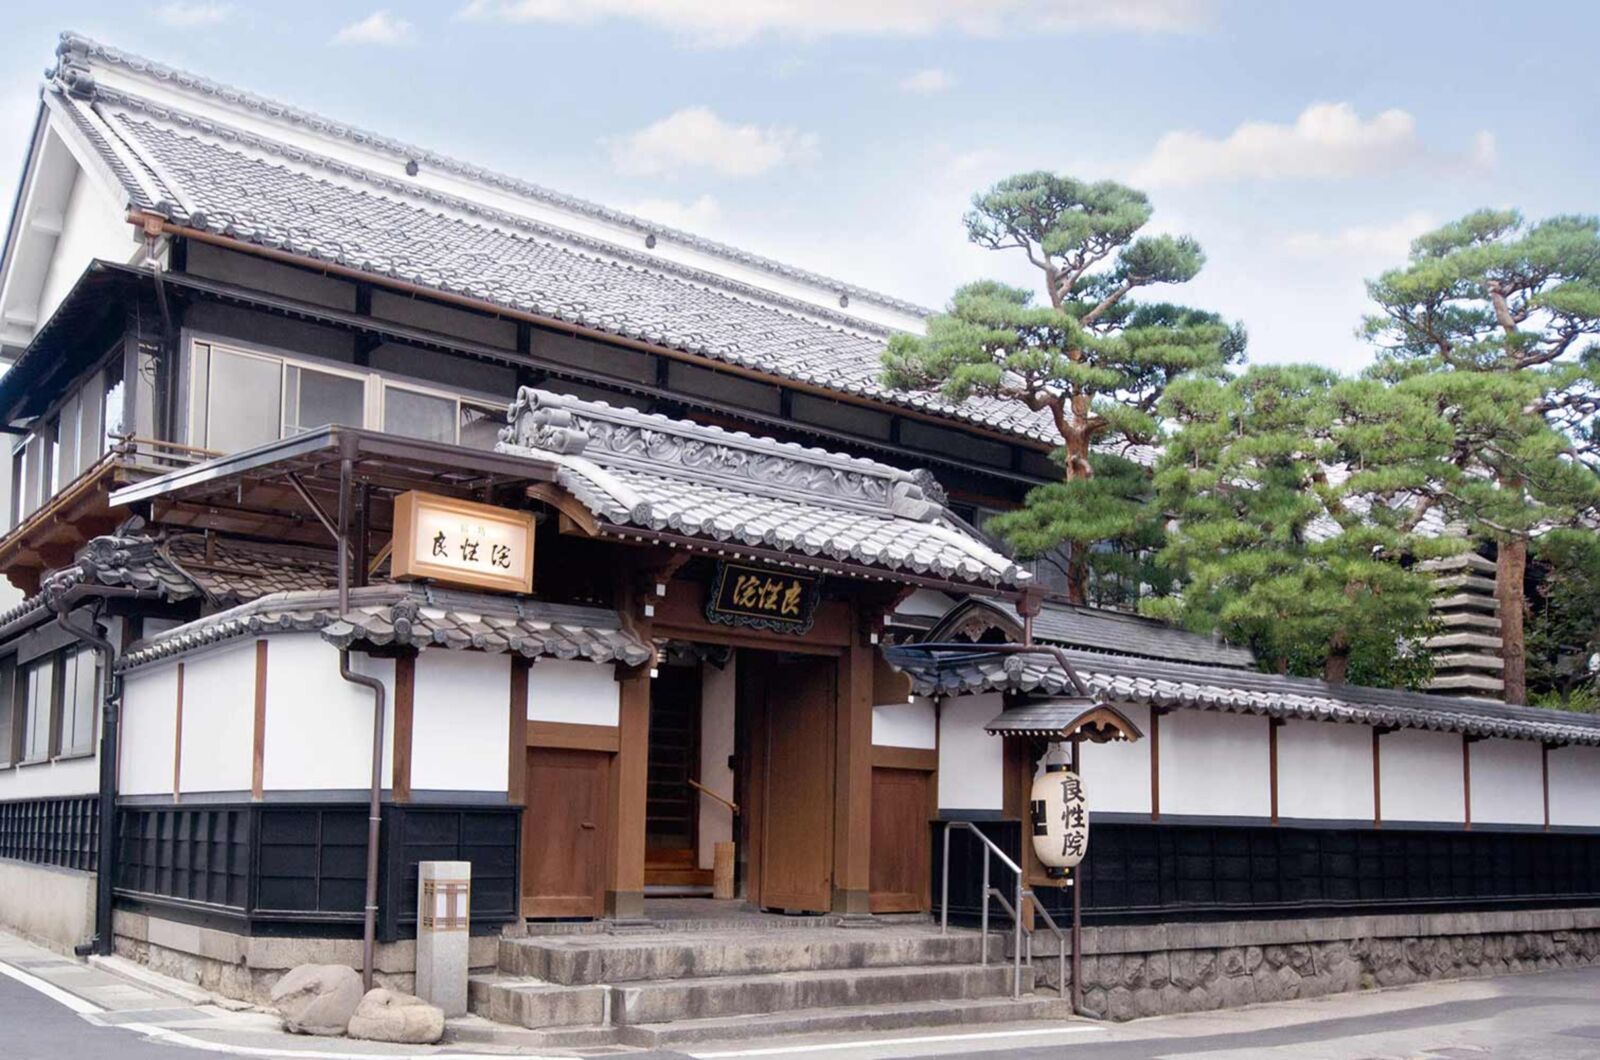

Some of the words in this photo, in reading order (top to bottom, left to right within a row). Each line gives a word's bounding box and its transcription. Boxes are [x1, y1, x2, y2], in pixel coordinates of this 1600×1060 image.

[432, 531, 511, 569] 良性院
[1060, 776, 1085, 857] 良性院
